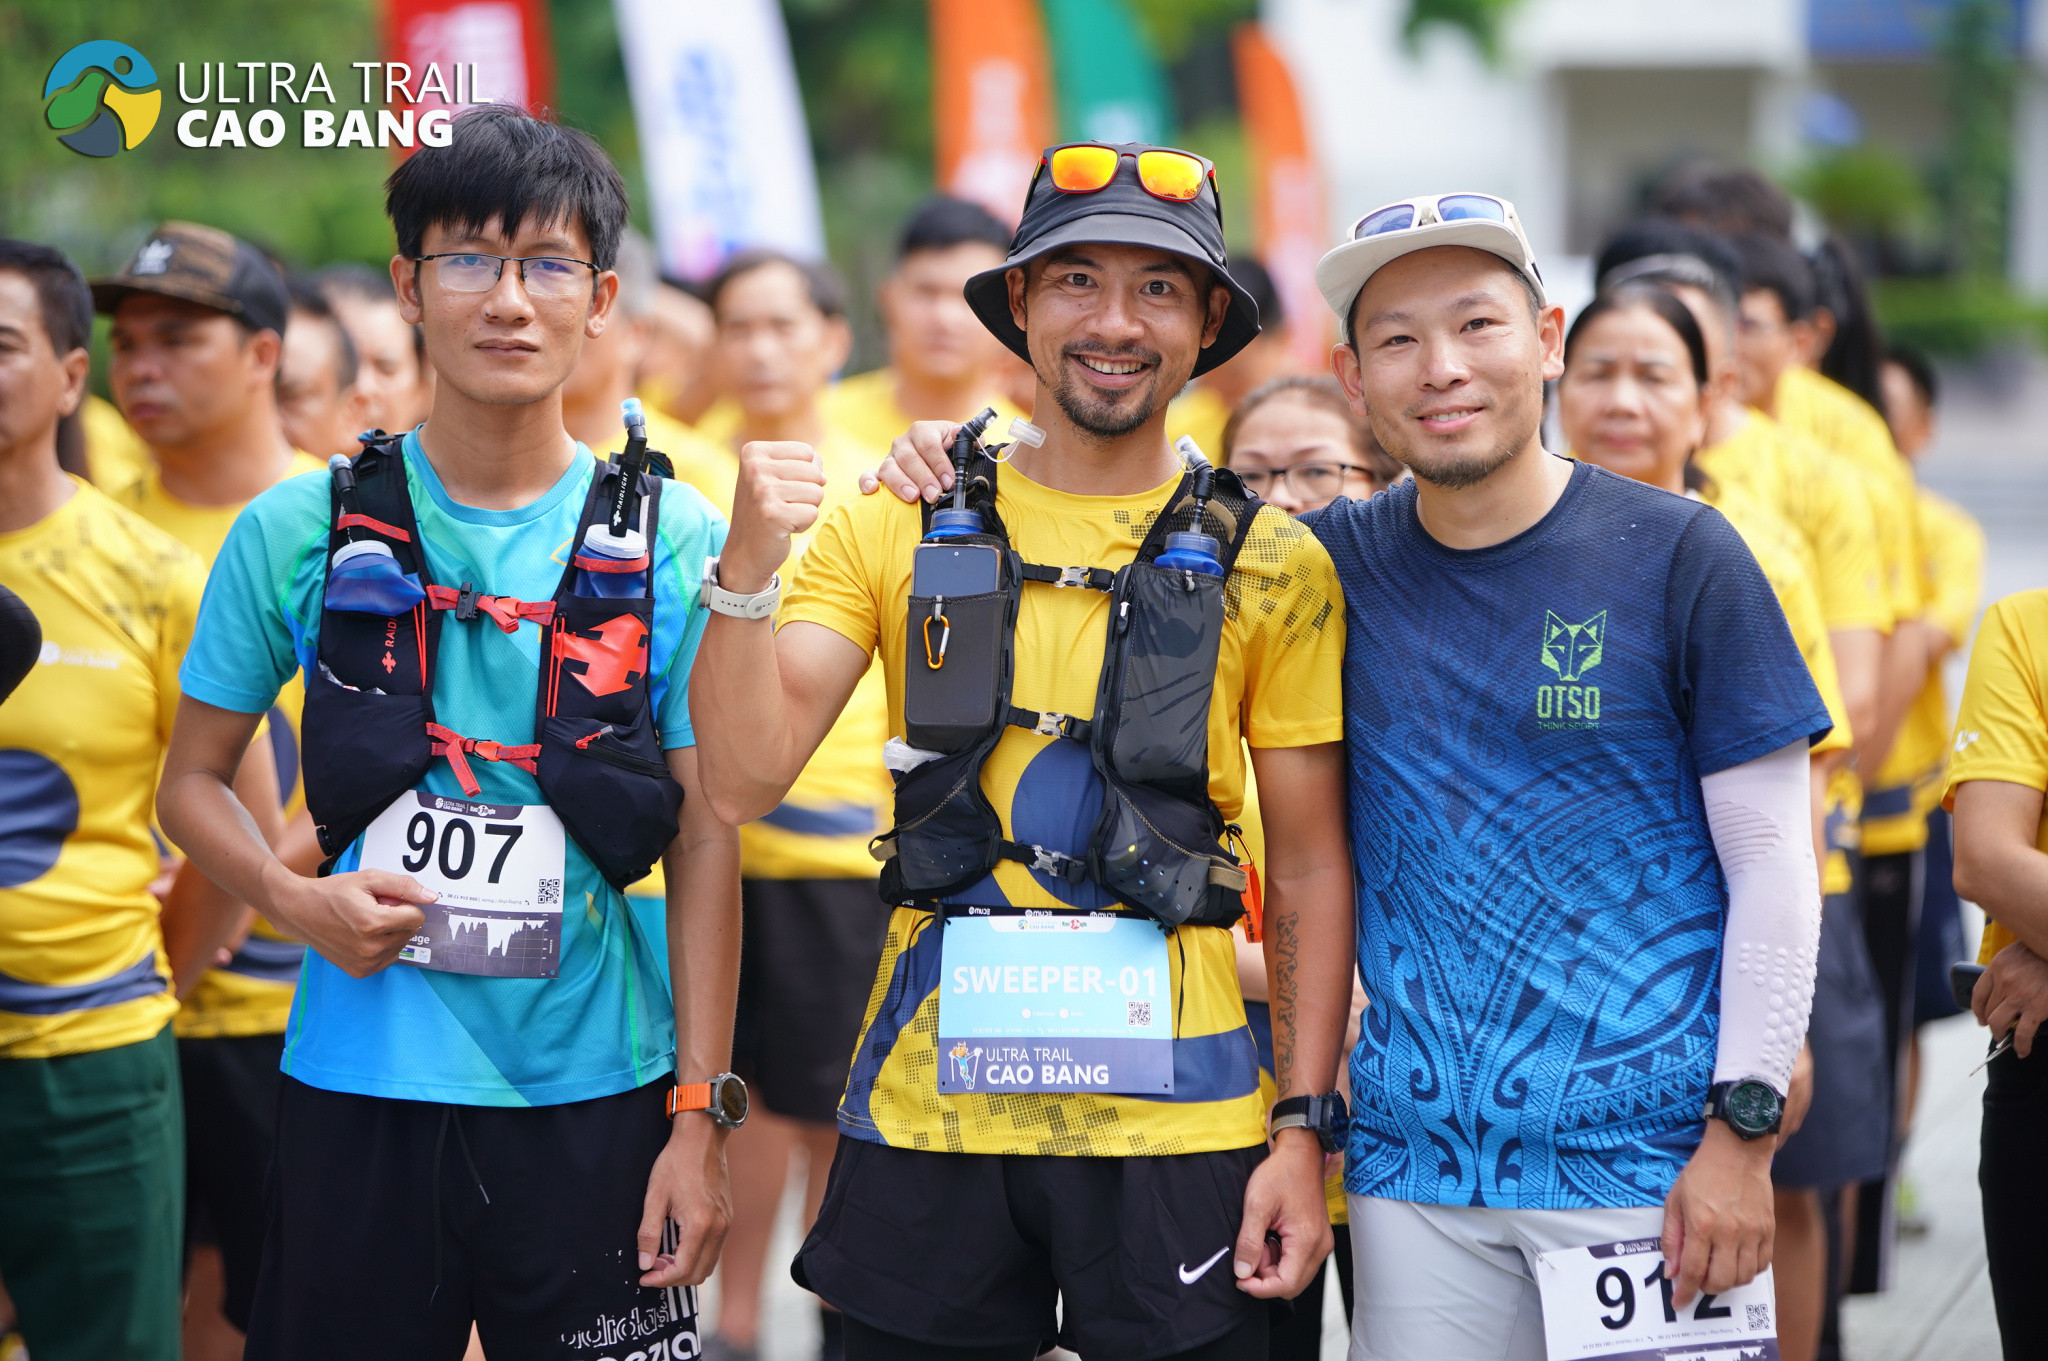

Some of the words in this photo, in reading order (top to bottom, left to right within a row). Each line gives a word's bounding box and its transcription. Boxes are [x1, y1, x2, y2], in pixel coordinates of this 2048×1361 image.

[616, 471, 629, 510] RAIDLIGHT
[1537, 685, 1601, 720] OTSO
[1537, 721, 1566, 730] THINK
[1568, 722, 1600, 731] SPORT
[402, 811, 523, 884] 907
[953, 966, 1156, 997] SWEEPER-01
[986, 1047, 1030, 1062] ULTRA
[1033, 1047, 1074, 1062] TRAIL
[986, 1065, 1034, 1085] CAO
[1041, 1065, 1109, 1085] BANG
